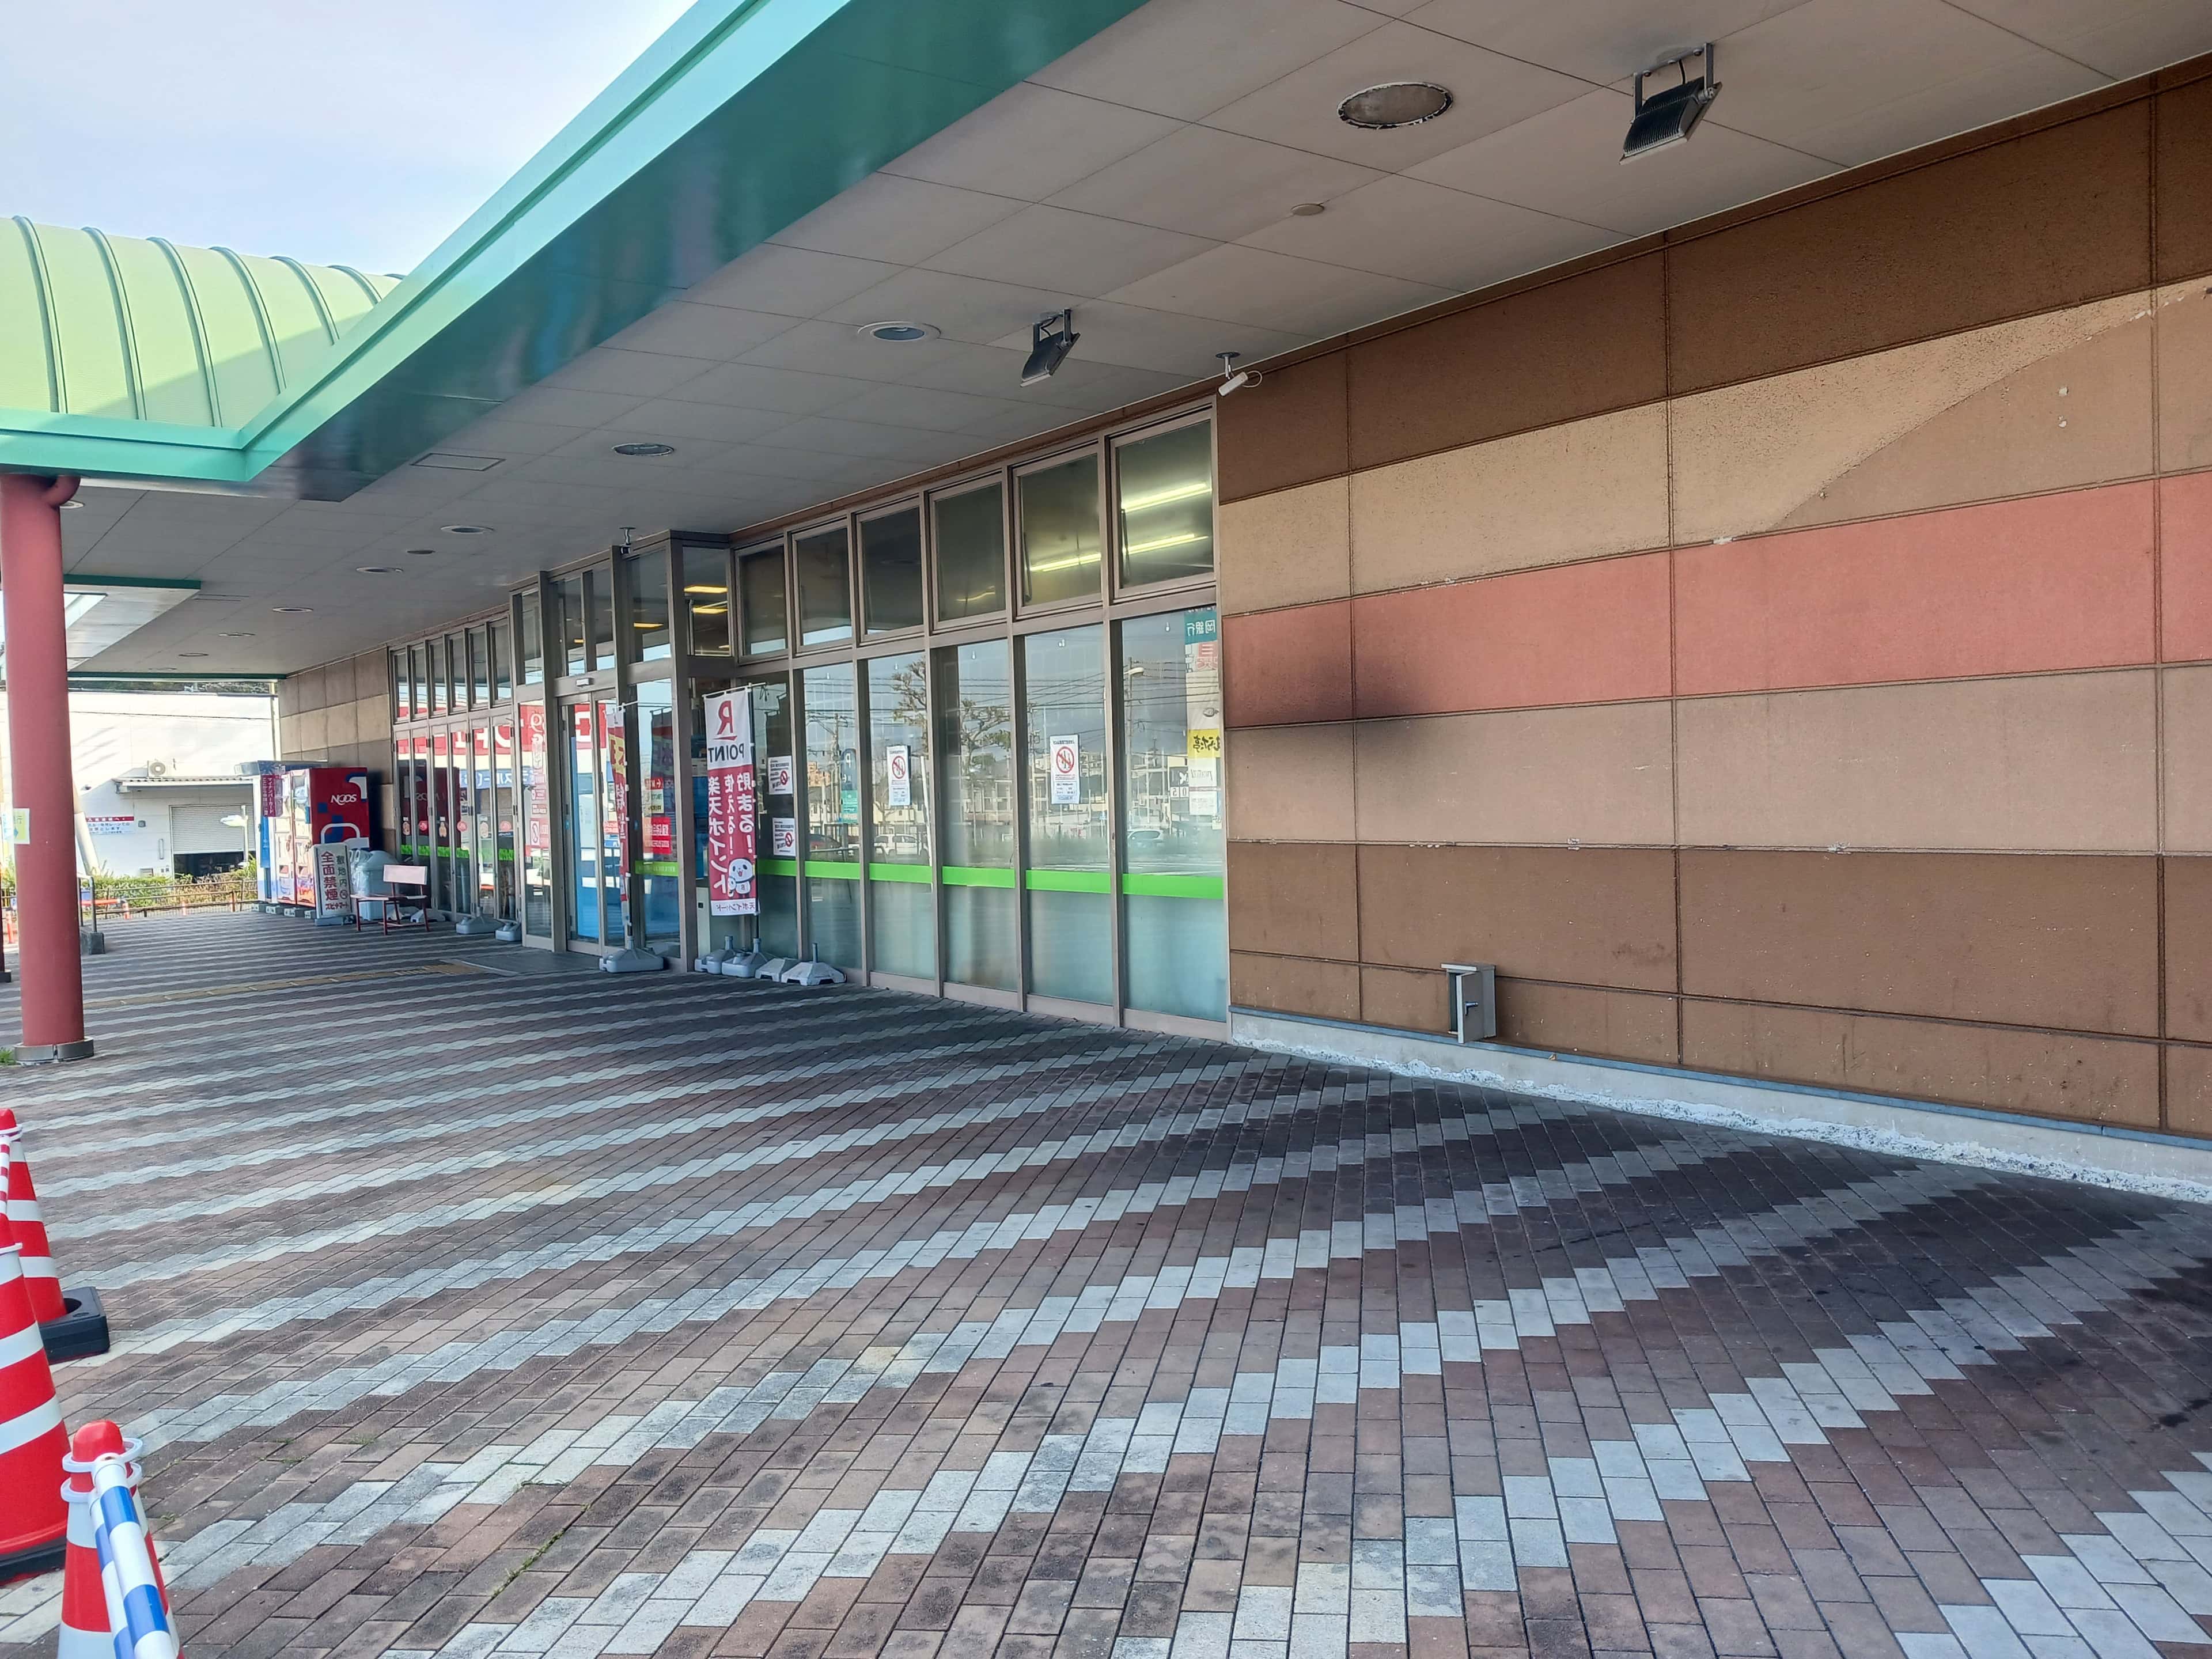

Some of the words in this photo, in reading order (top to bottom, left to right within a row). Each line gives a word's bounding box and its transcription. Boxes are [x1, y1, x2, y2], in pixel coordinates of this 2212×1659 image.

[321, 851, 338, 901] 全面禁煙
[336, 855, 347, 887] 敷地内
